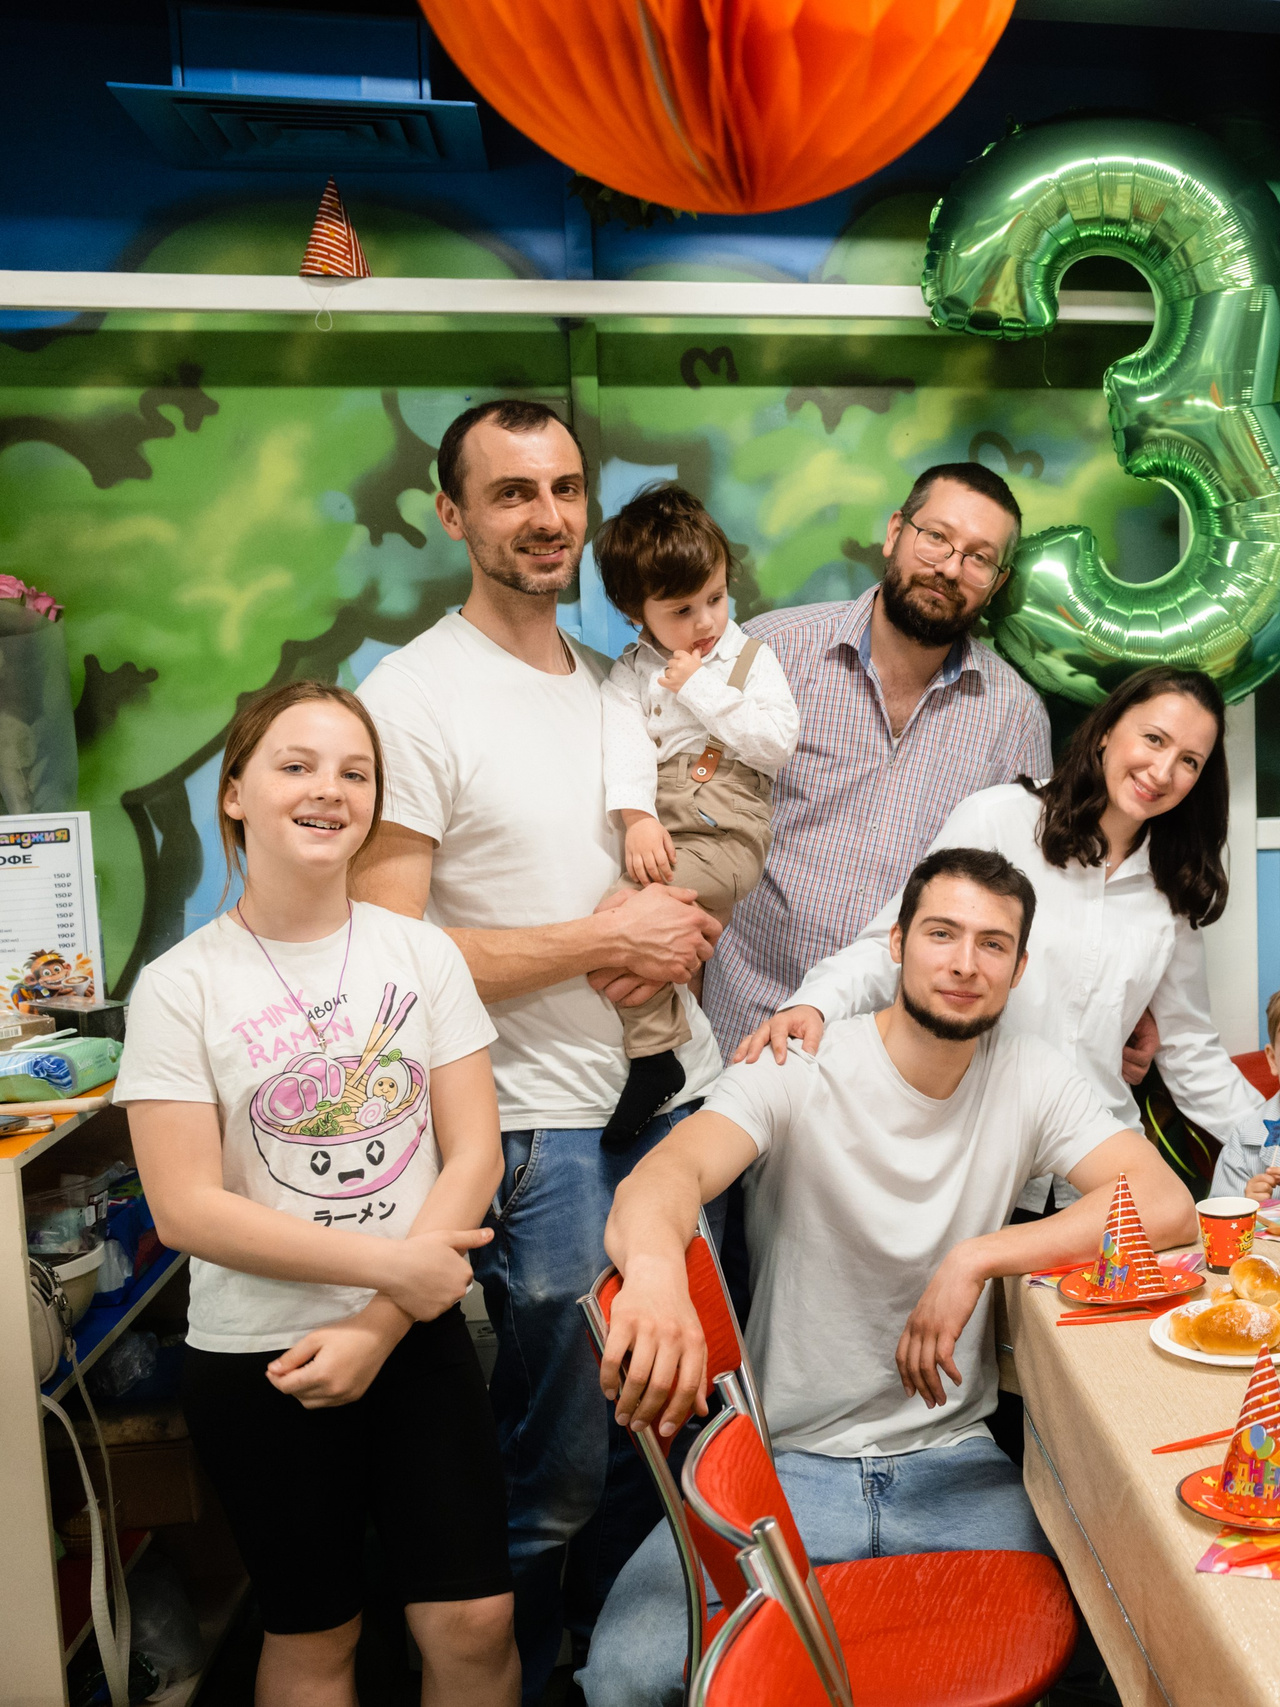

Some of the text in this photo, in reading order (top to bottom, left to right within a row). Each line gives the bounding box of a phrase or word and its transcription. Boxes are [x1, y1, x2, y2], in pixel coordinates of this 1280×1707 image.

[231, 989, 348, 1045] THINK ABOUT
[313, 1201, 396, 1228] ラーメン
